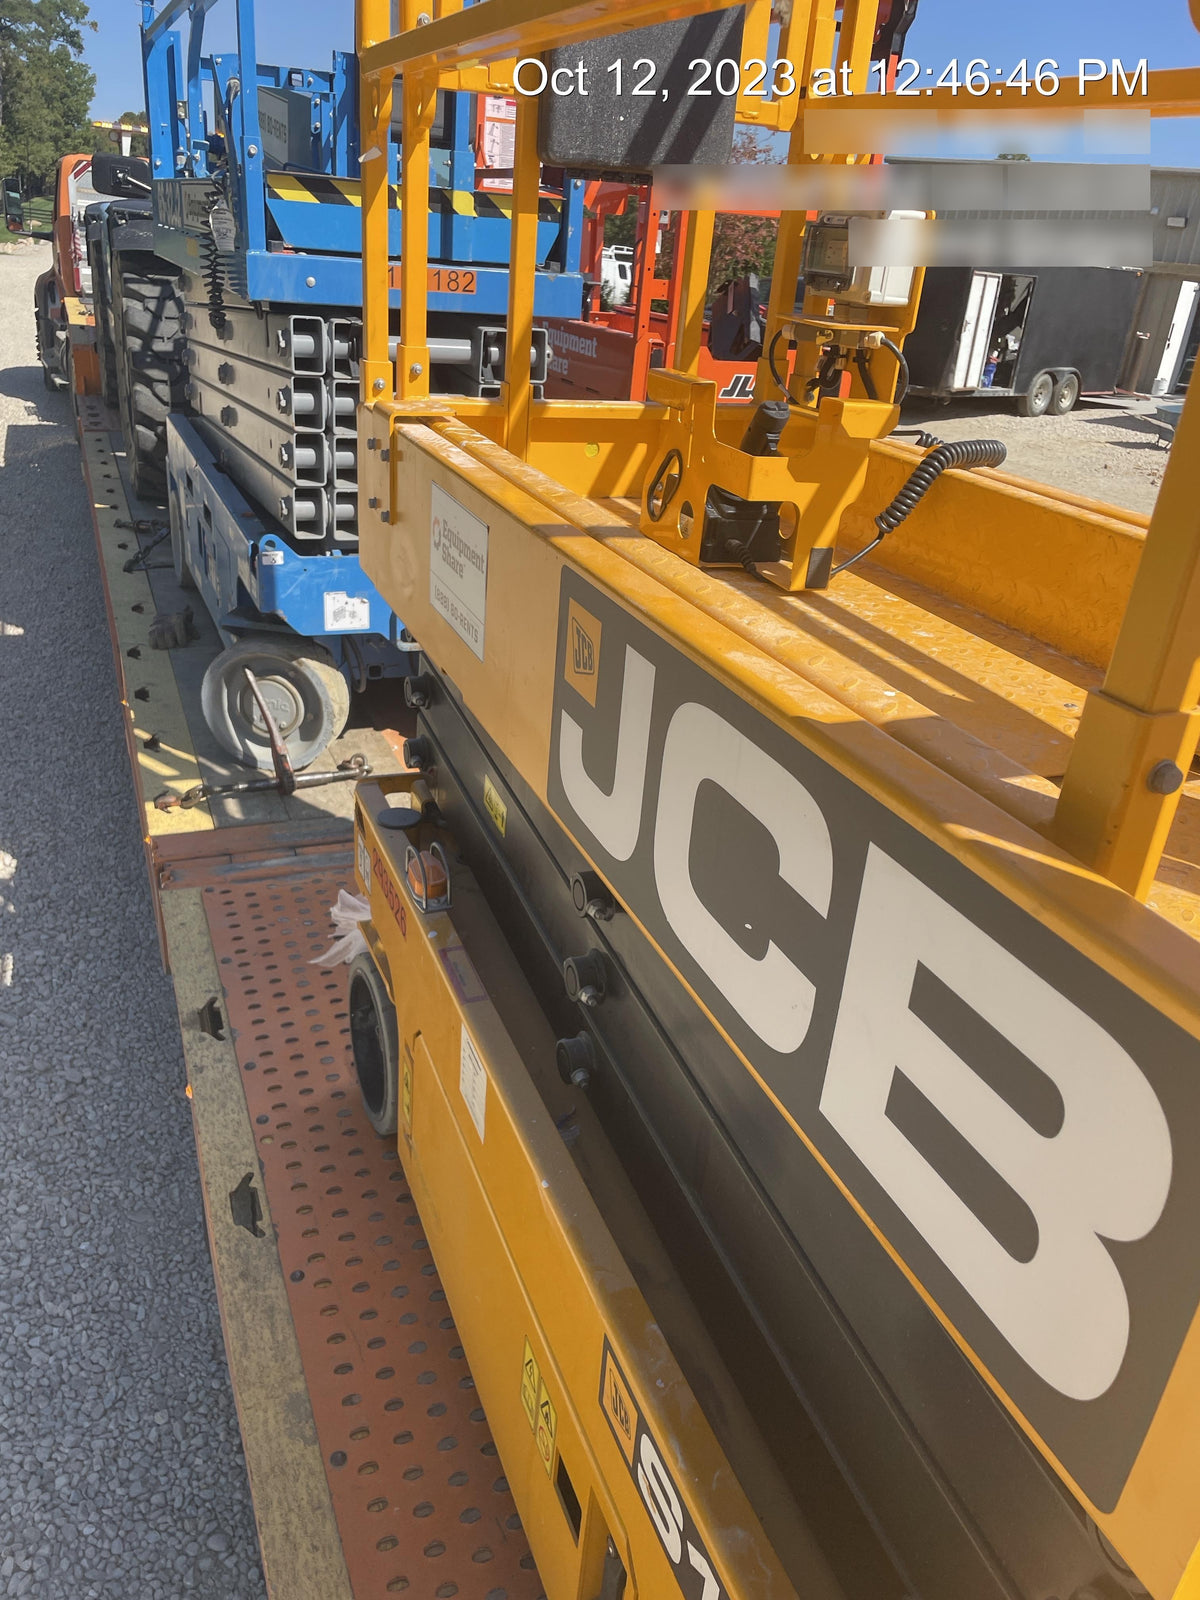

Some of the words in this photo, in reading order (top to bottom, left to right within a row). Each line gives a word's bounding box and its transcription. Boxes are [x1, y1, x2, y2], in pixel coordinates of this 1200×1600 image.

[543, 320, 598, 358] quipment
[718, 374, 756, 399] JL
[441, 545, 464, 580] Share
[442, 518, 485, 575] Equipment
[450, 606, 479, 644] 80-RENTS
[574, 624, 593, 671] JCB
[559, 643, 1173, 1401] JCB
[612, 1381, 631, 1436] JCB
